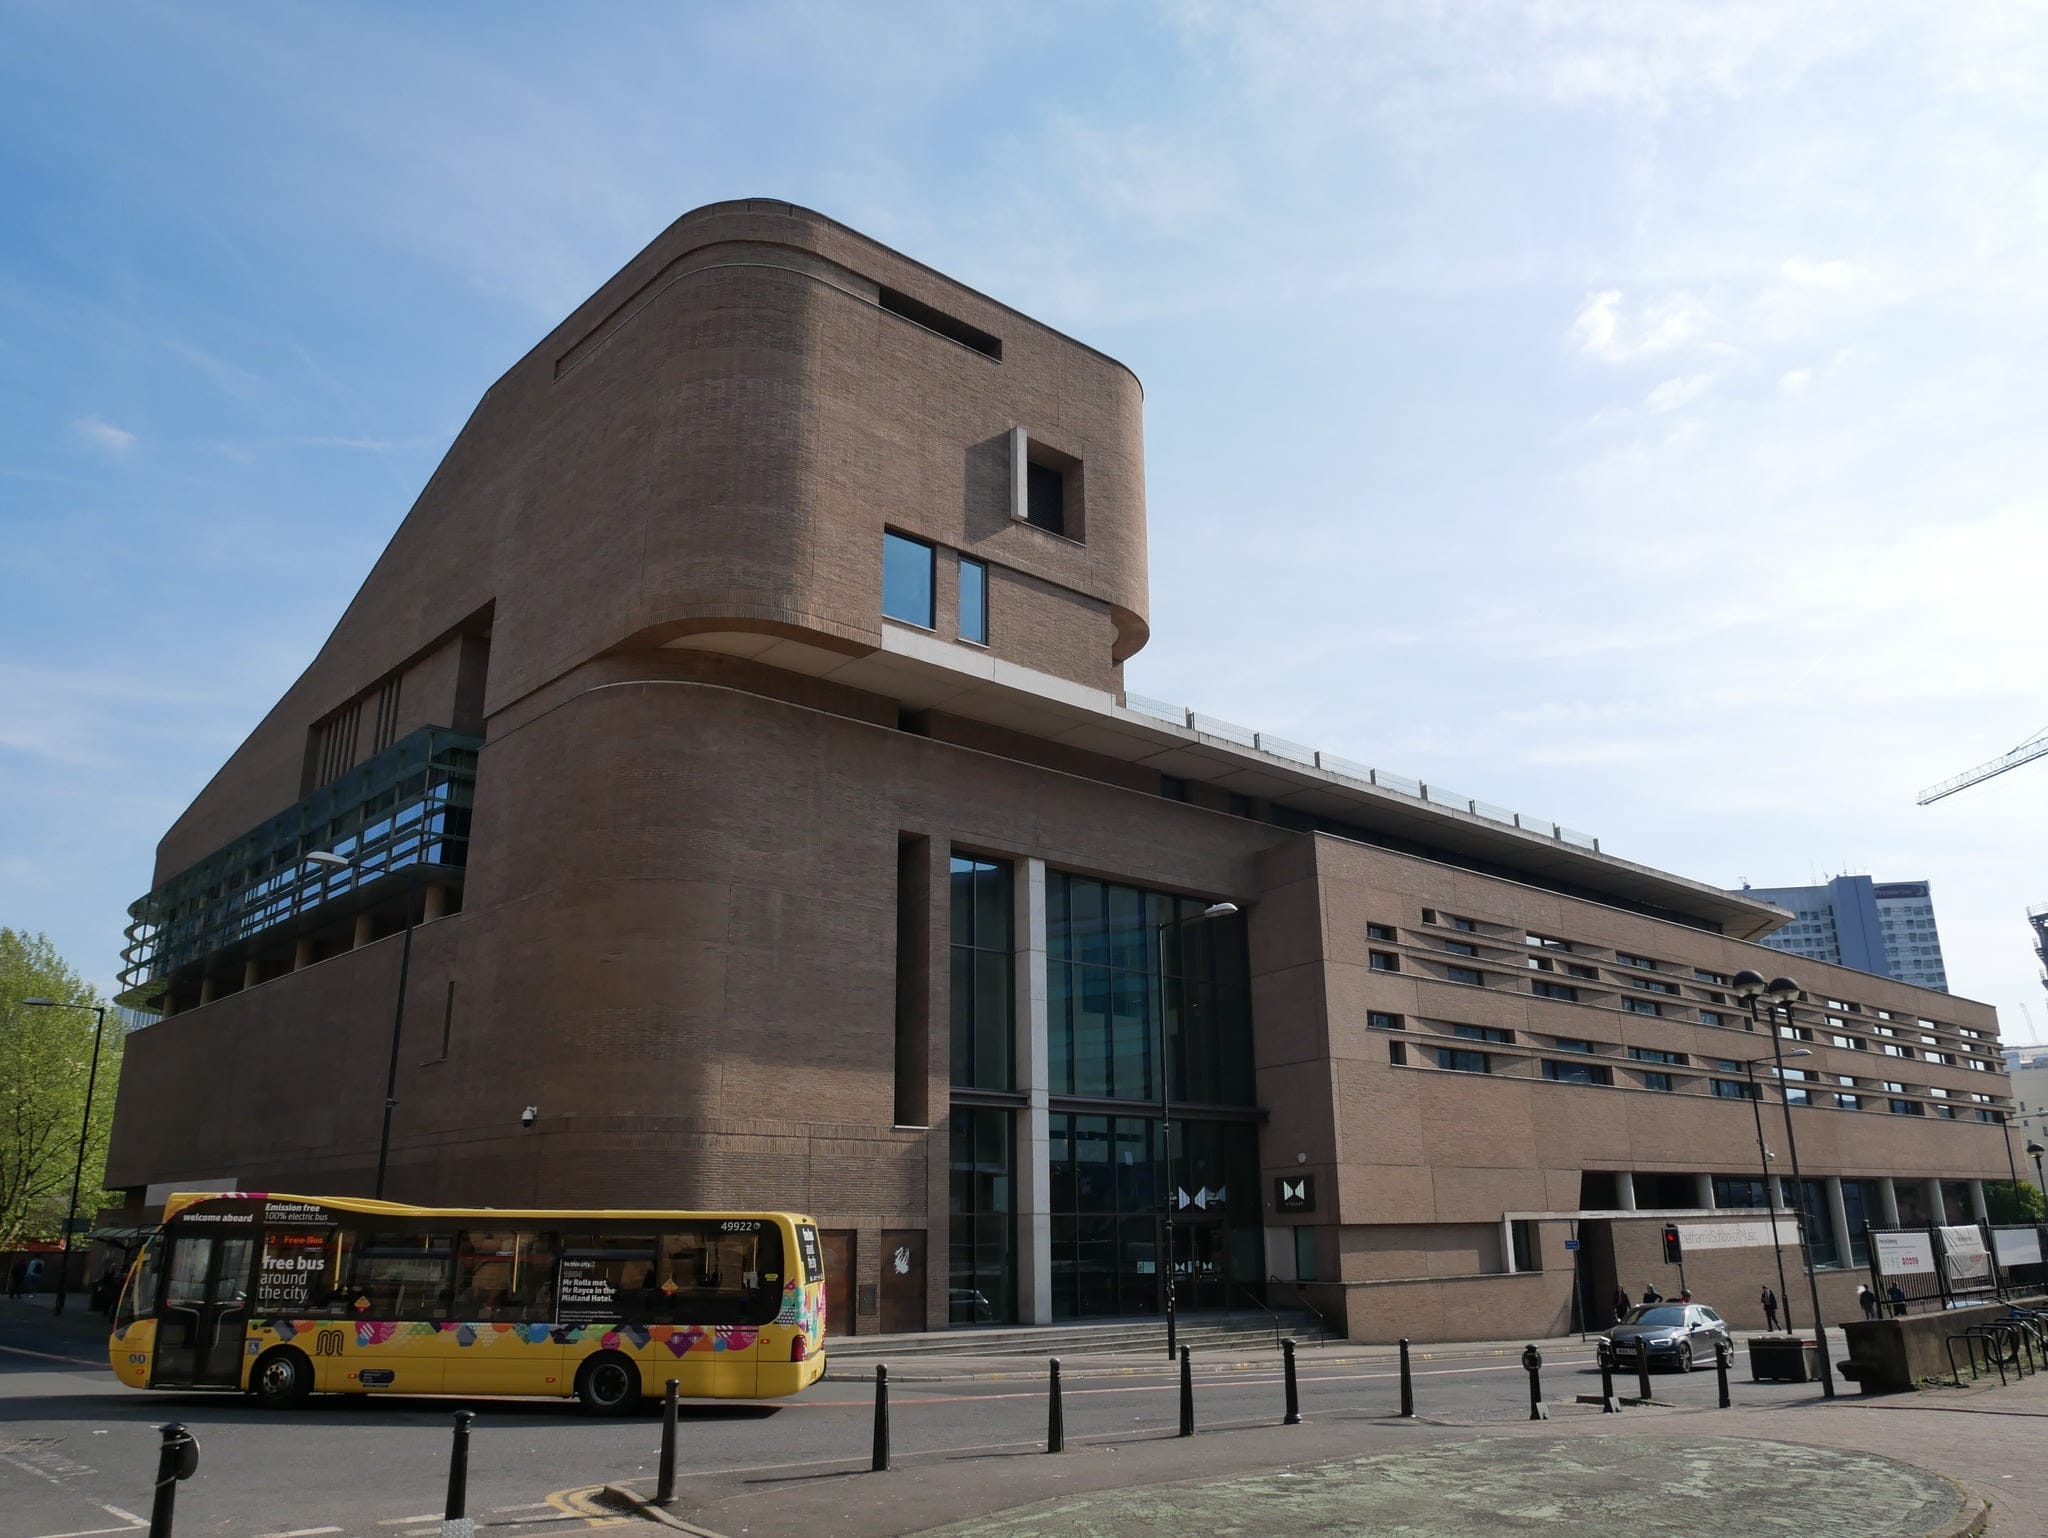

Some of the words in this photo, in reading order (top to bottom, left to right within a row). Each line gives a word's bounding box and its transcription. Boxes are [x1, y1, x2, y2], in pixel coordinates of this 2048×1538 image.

[265, 1203, 301, 1212] Emission
[302, 1203, 320, 1212] free
[183, 1213, 221, 1222] welcome
[222, 1213, 253, 1222] aboard
[265, 1211, 287, 1220] 100%
[288, 1212, 314, 1221] electric
[315, 1213, 328, 1221] bus
[721, 1221, 752, 1231] 49922
[263, 1256, 295, 1270] free
[296, 1256, 325, 1270] bus
[260, 1272, 307, 1285] around
[259, 1285, 281, 1300] the
[573, 1287, 594, 1295] Royce
